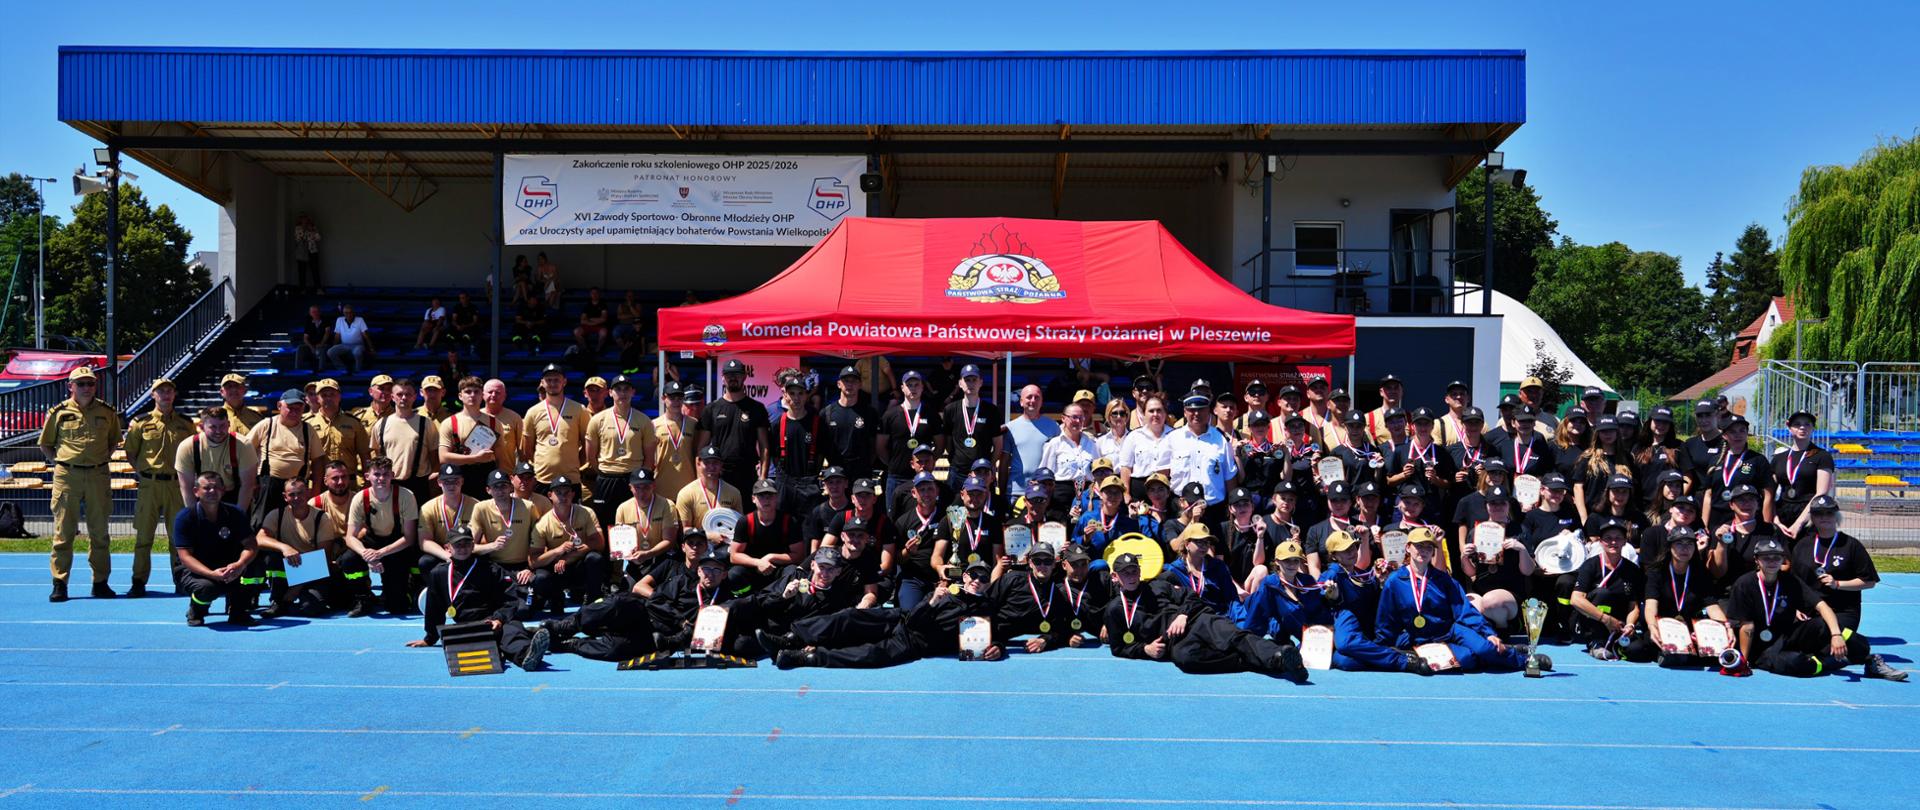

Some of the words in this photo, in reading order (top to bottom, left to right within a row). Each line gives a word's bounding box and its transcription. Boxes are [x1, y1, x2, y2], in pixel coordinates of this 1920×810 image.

[572, 160, 629, 169] Zakończenie
[631, 160, 652, 169] roku
[654, 160, 720, 171] szkoleniowego
[722, 161, 745, 170] OHP
[747, 161, 798, 170] 2025/2026
[524, 199, 553, 208] OHP
[816, 200, 845, 209] OHP
[574, 213, 591, 221] XVI
[593, 213, 629, 223] Zawody
[681, 213, 721, 222] Obronne
[723, 213, 770, 224] Młodzieży
[772, 214, 795, 223] OHP
[519, 228, 537, 236] oraz
[540, 227, 584, 237] Uroczysty
[586, 226, 605, 236] apel
[607, 226, 675, 237] upamiętniający
[677, 226, 726, 236] bohaterów
[727, 227, 774, 237] Powstania
[742, 321, 822, 337] Komenda
[828, 322, 922, 338] Powiatowa
[928, 323, 1031, 342] Państwowej
[1035, 325, 1086, 343] Straży
[1091, 325, 1163, 343] Pożarnej
[1169, 329, 1185, 341] w
[1190, 326, 1272, 342] Pleszewie
